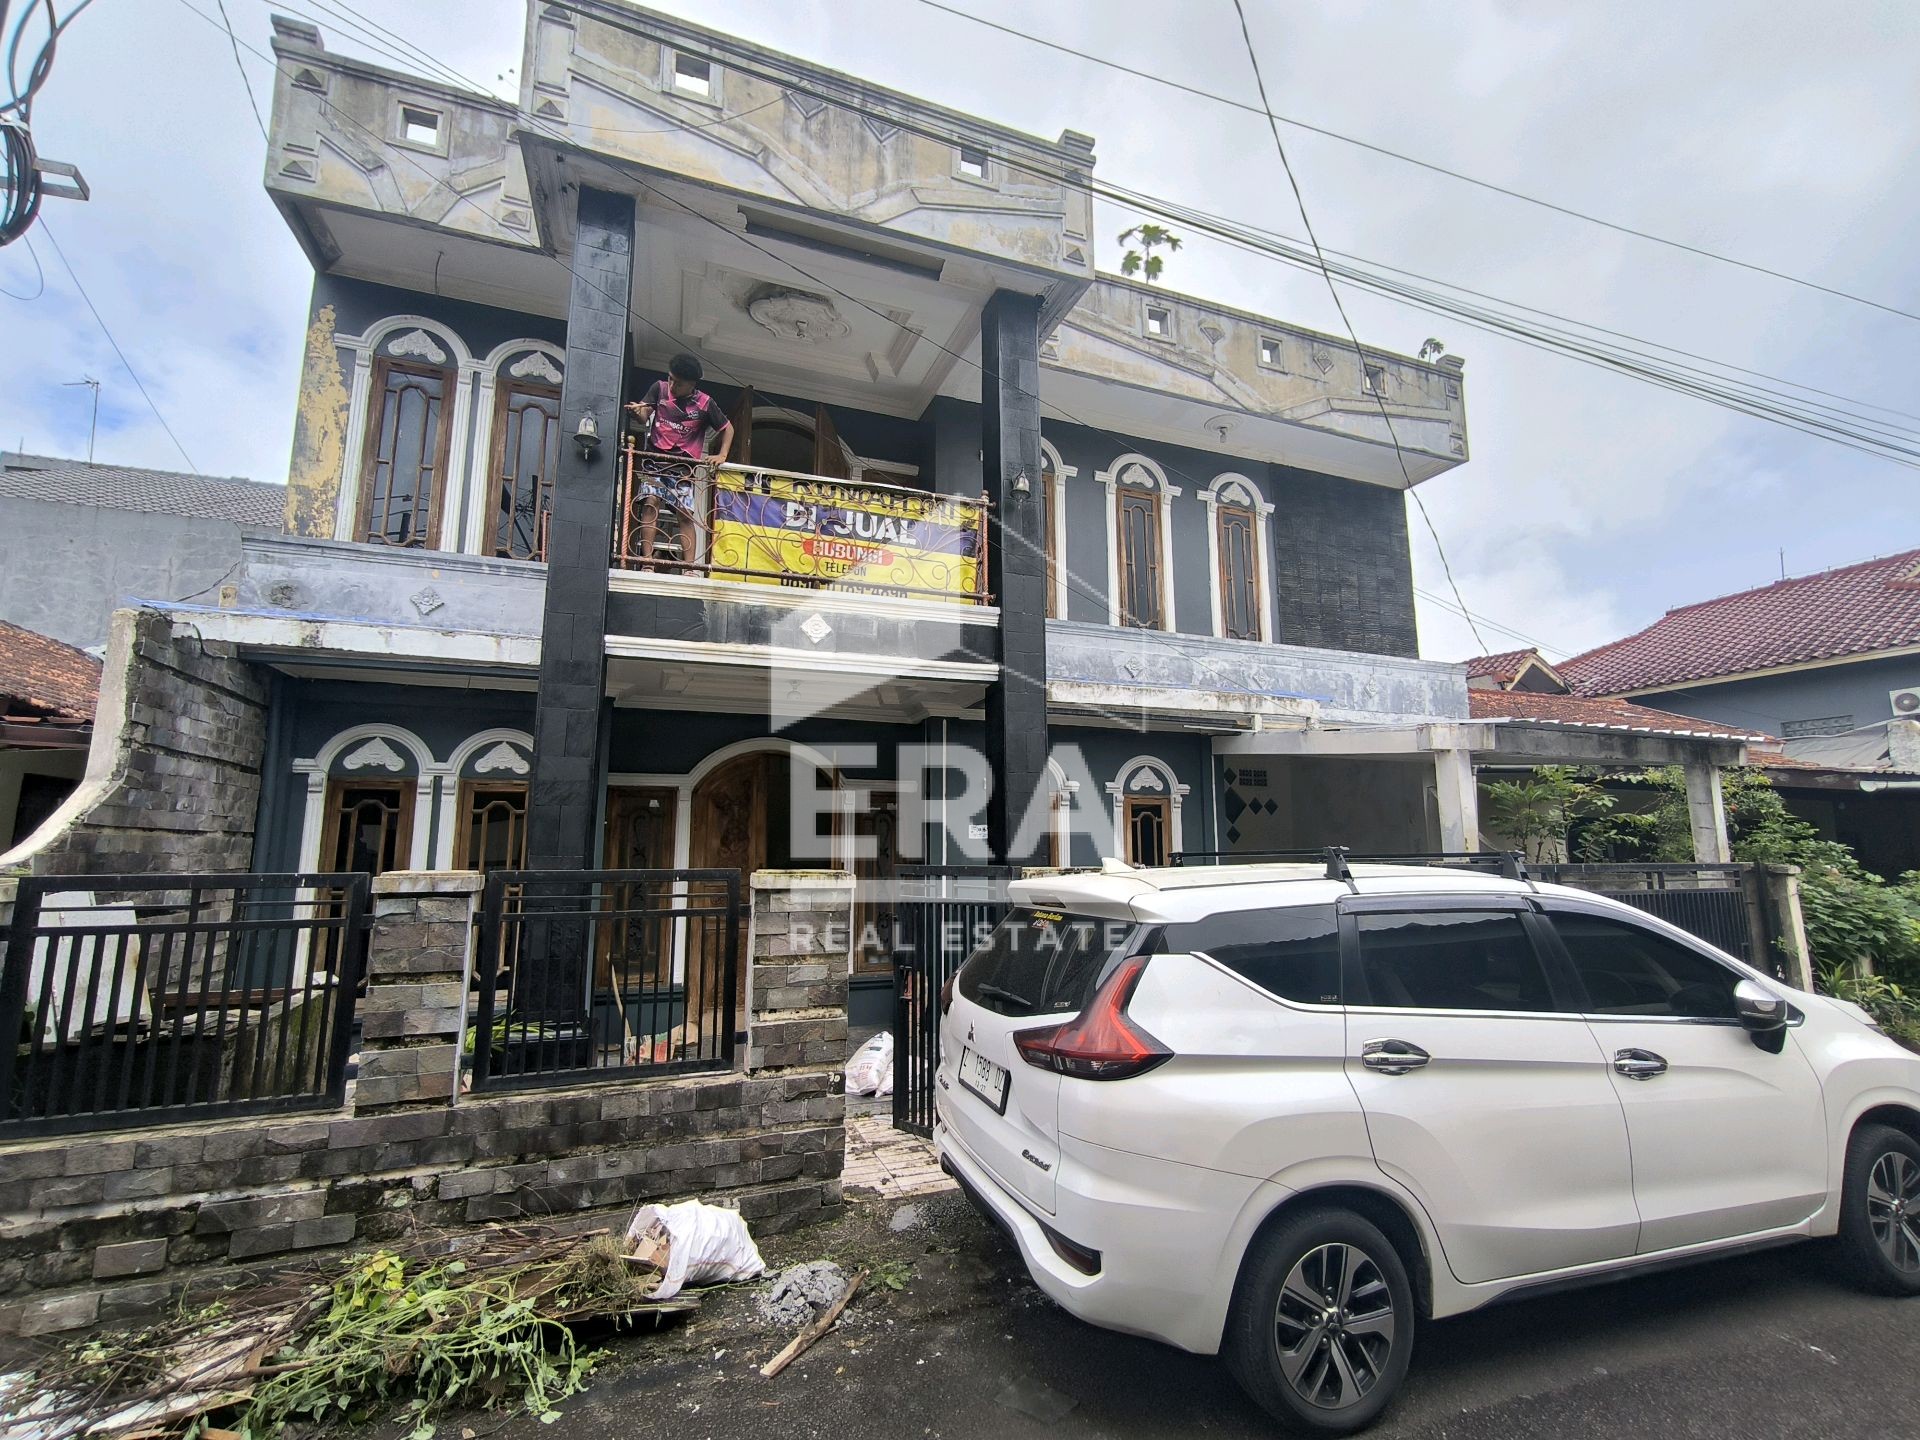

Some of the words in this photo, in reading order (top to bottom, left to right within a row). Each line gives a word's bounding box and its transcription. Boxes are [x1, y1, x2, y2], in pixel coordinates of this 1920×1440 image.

[786, 501, 817, 530] DI
[834, 510, 917, 545] JUAL
[813, 540, 883, 564] HUBUNGI
